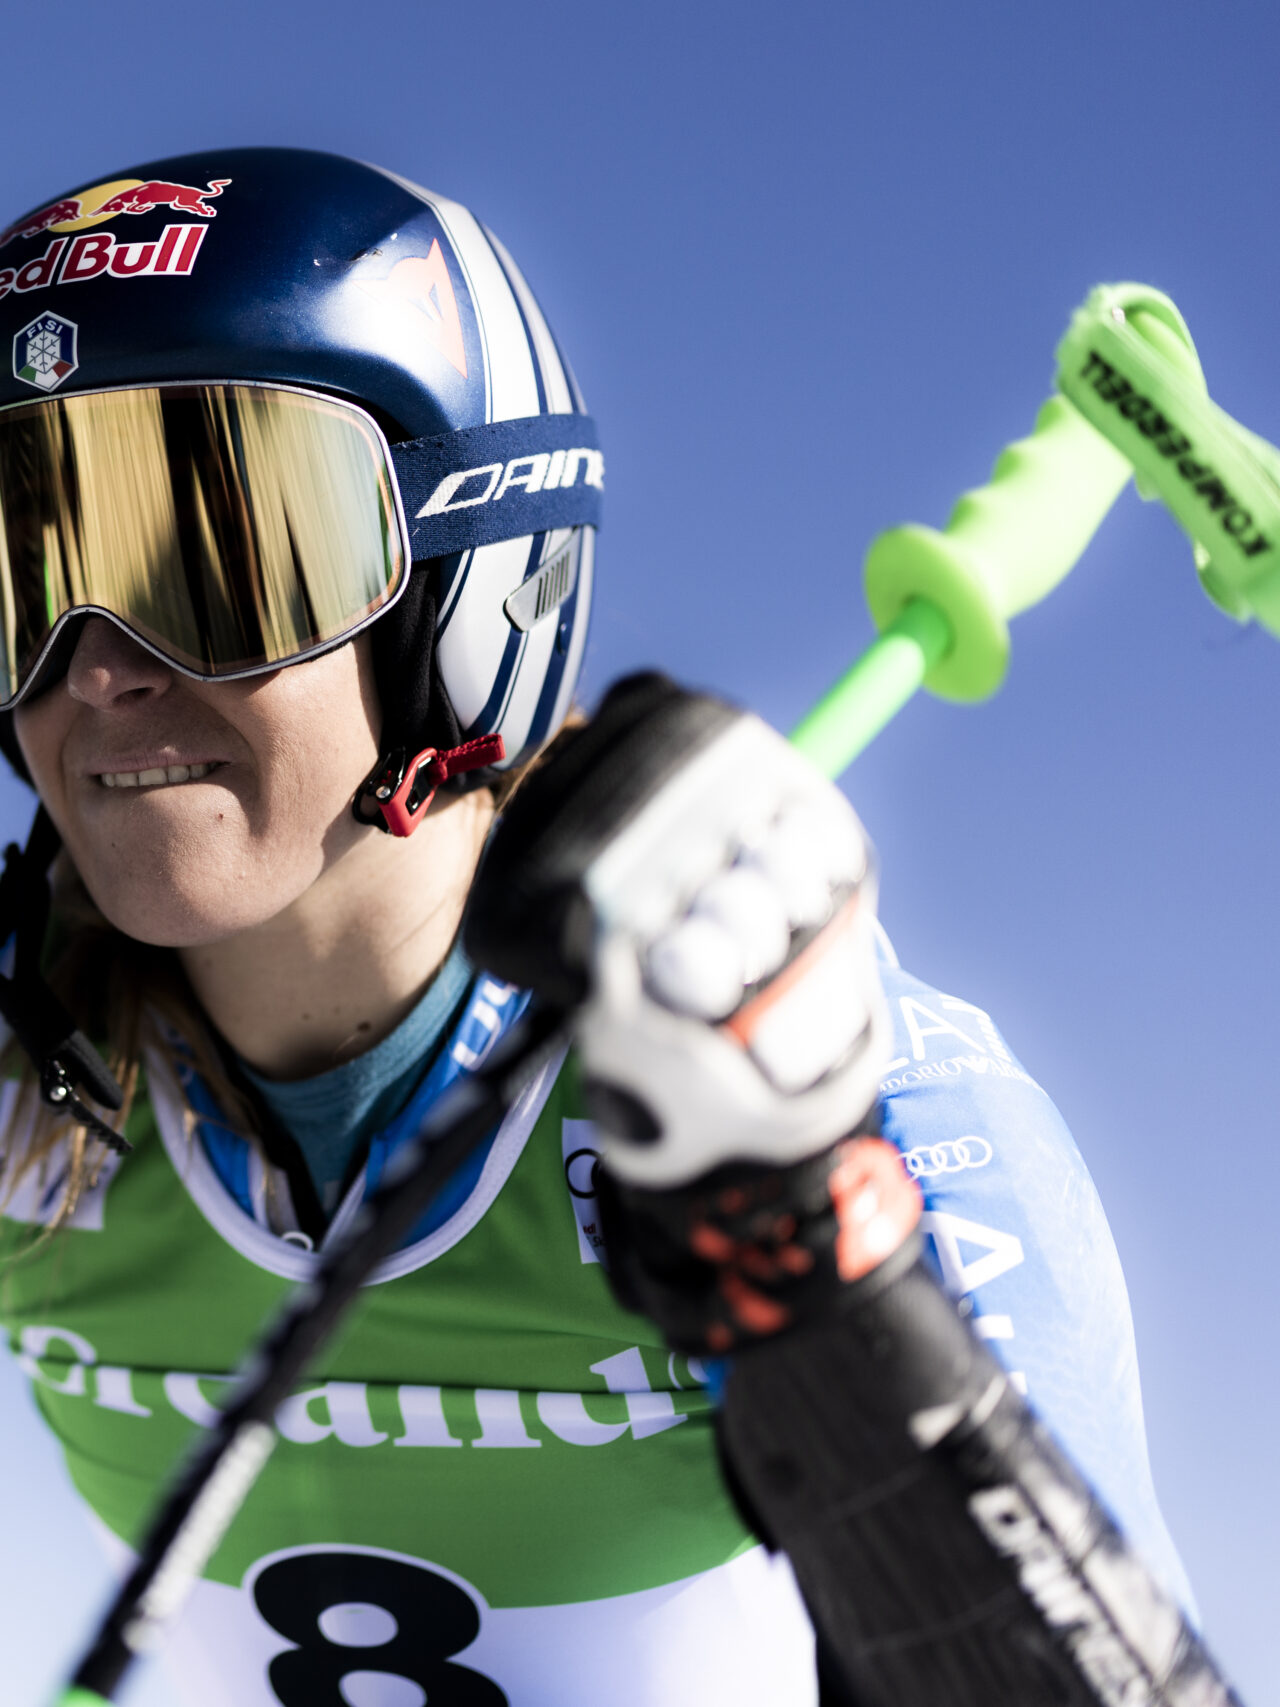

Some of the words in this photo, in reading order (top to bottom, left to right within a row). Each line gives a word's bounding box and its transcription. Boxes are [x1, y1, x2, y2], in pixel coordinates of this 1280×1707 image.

[58, 223, 209, 286] Bull
[26, 319, 64, 339] FISI
[253, 1551, 511, 1707] 8
